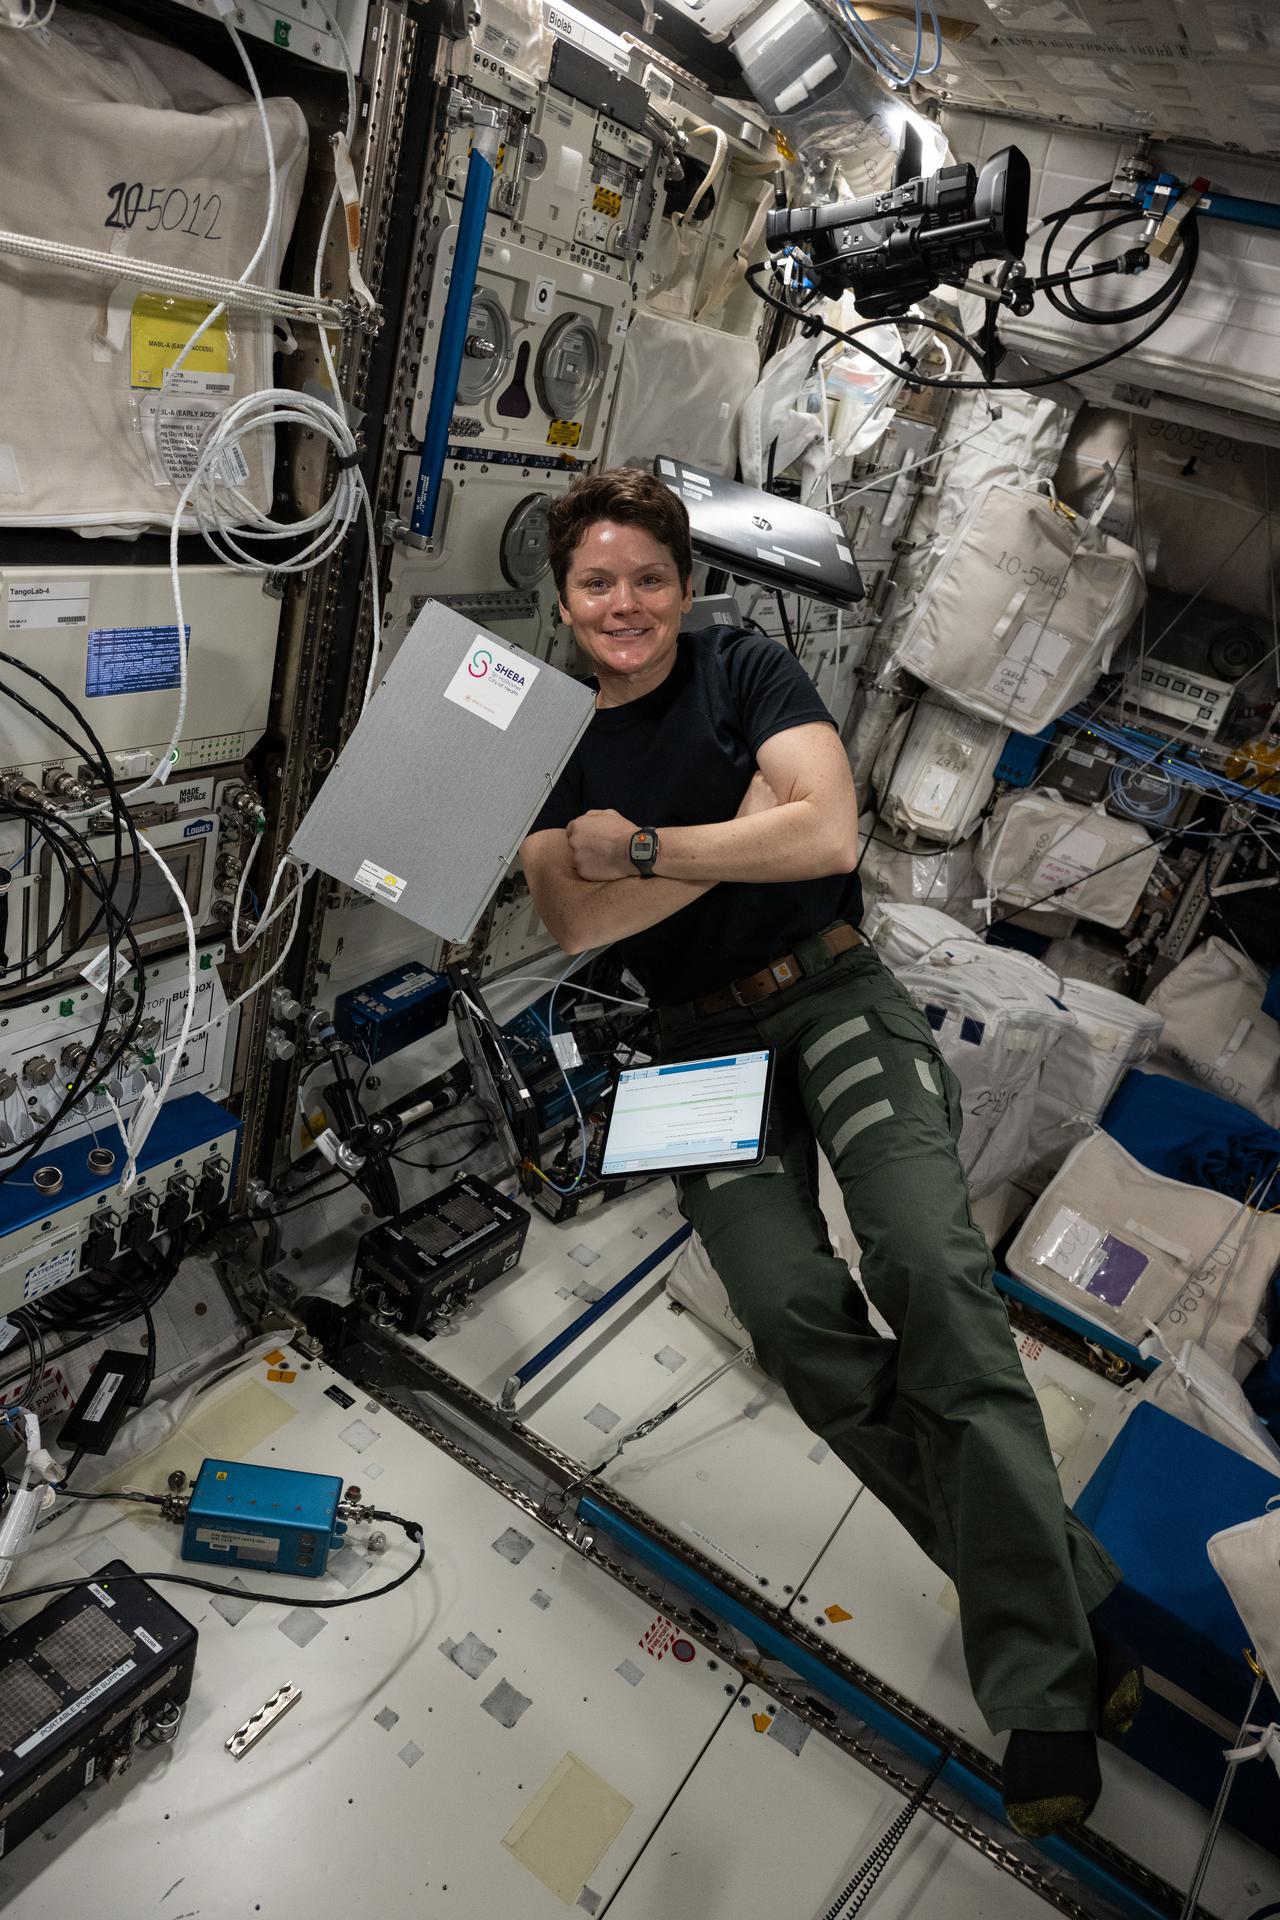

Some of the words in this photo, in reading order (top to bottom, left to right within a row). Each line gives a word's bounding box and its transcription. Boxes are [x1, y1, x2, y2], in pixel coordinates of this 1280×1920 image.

[549, 11, 572, 34] Biolab
[150, 408, 175, 416] MBL-A
[176, 409, 198, 417] (EARLY
[10, 588, 50, 597] TangoLab-4
[494, 663, 525, 686] SHEBA
[180, 787, 200, 796] MADE
[187, 792, 206, 803] SPACE
[187, 824, 211, 836] LOWE'S
[32, 1256, 70, 1278] ATTENTION
[36, 1390, 59, 1407] PORT
[40, 1705, 76, 1737] PORTABLE
[76, 1687, 101, 1708] POWER
[101, 1666, 127, 1689] SUPPLY
